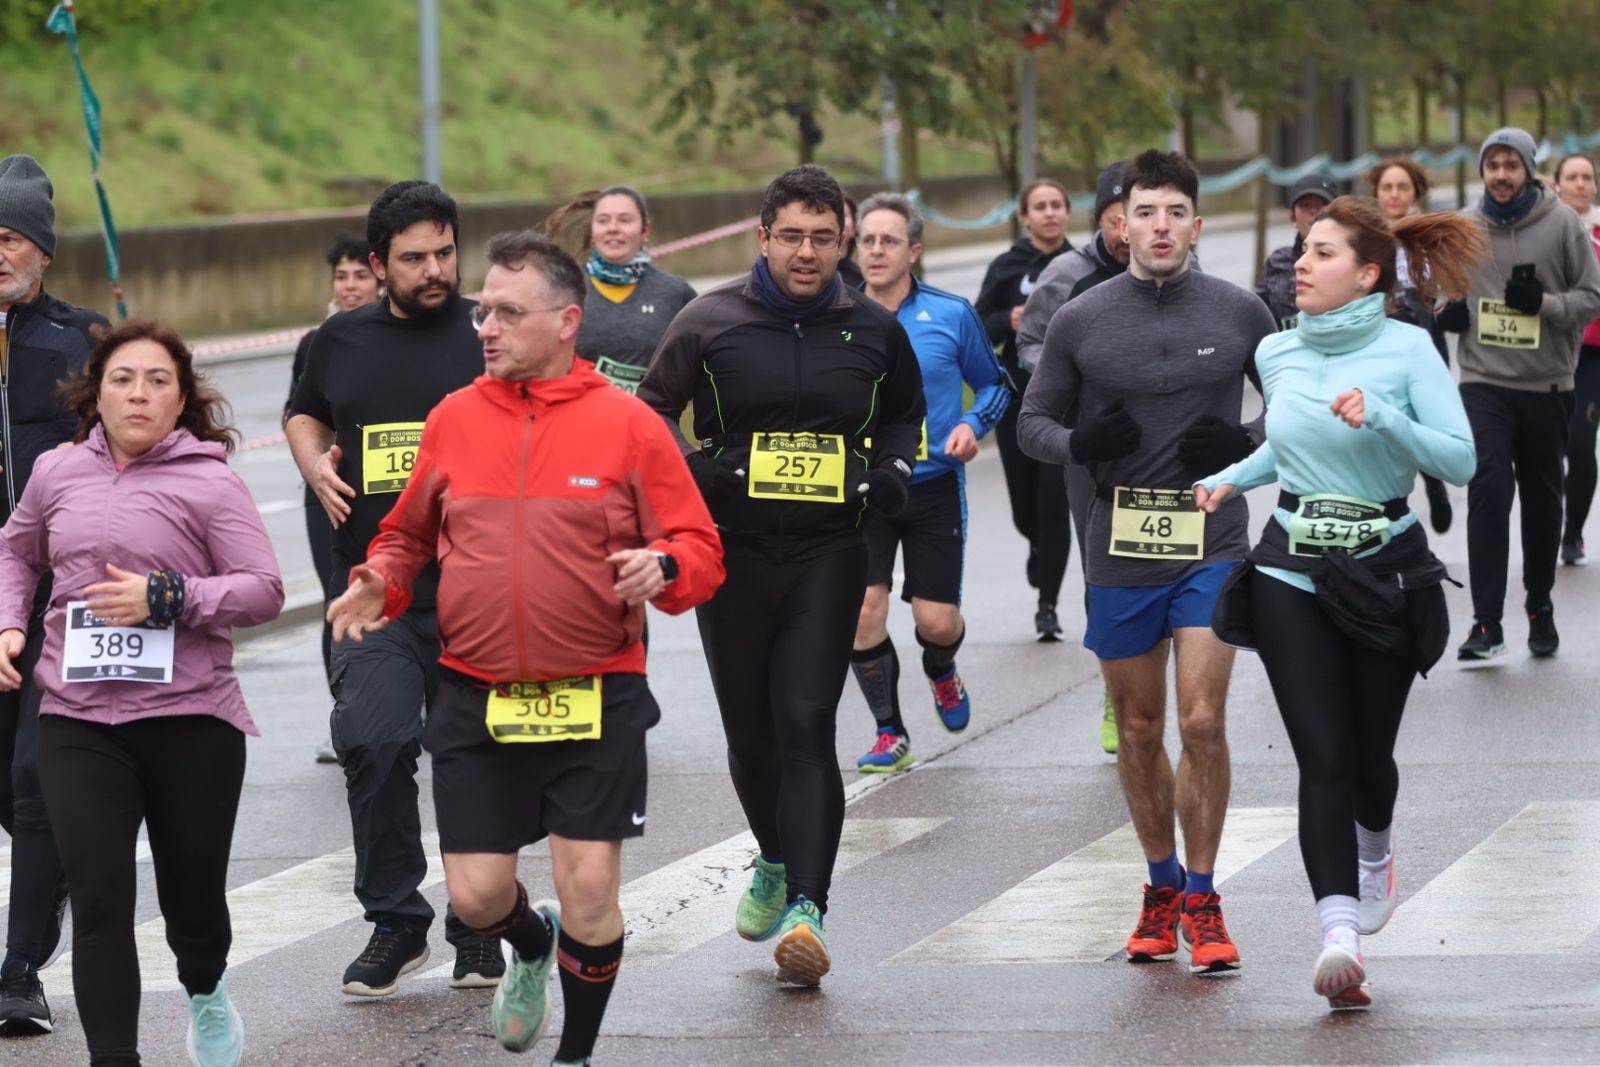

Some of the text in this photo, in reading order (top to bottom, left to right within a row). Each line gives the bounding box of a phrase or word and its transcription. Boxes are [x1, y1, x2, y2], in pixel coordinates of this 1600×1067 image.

[1498, 318, 1517, 334] 34
[796, 441, 817, 449] BOSCO
[775, 455, 822, 478] 257
[1336, 507, 1361, 517] BOSCO
[1140, 515, 1172, 538] 48
[1306, 522, 1372, 541] 1378
[90, 632, 144, 659] 389
[515, 695, 570, 718] 305
